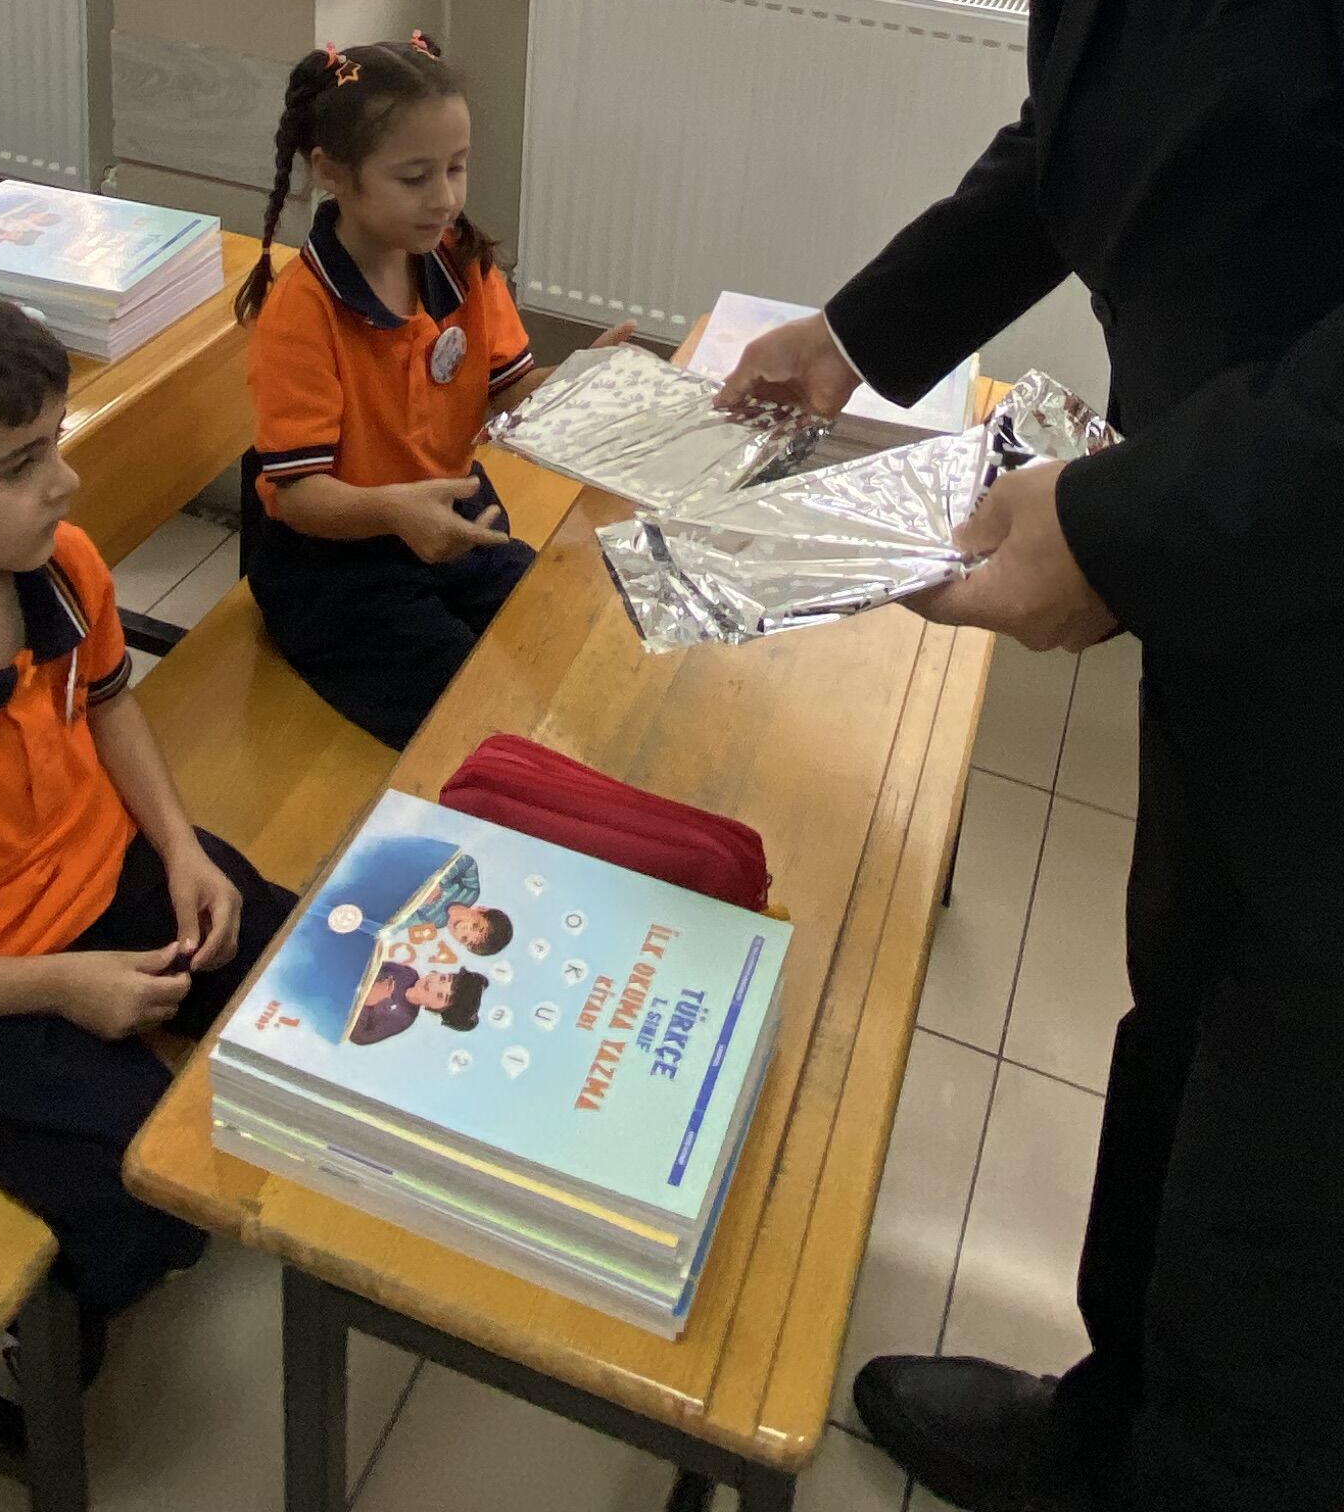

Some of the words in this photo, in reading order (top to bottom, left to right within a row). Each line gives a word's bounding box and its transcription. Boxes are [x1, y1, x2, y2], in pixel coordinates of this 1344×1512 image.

[640, 923, 681, 960] İLK
[576, 975, 615, 1031] KİTABI
[608, 962, 656, 1030] OKUMA
[636, 1011, 664, 1053] SINIF
[650, 988, 709, 1080] TÜRKÇE
[574, 1039, 627, 1110] YAZMA
